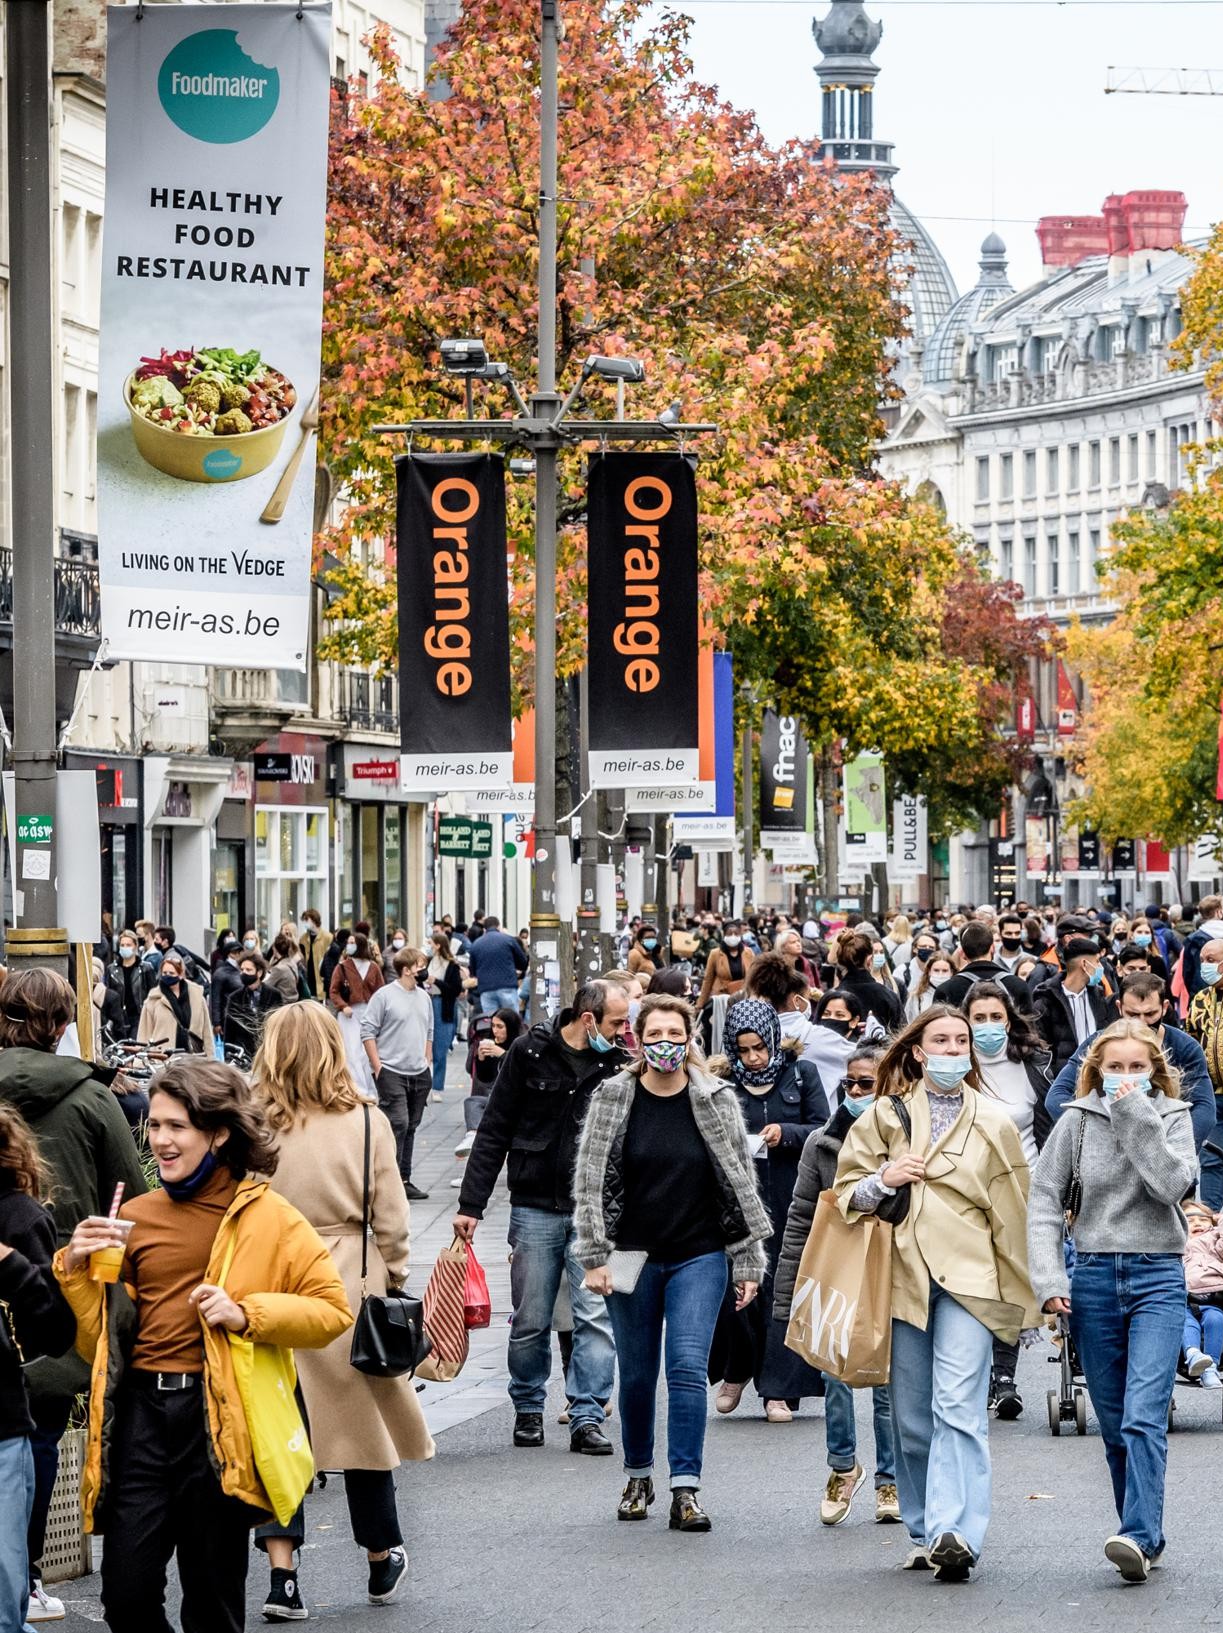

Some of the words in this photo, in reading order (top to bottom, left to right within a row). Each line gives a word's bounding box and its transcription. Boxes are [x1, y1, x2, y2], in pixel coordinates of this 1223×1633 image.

[172, 71, 268, 98] Foodmaker
[150, 187, 283, 216] HEALTHY
[175, 223, 256, 248] FOOD
[117, 255, 310, 288] RESTAURANT
[122, 552, 169, 571] LIVING
[173, 555, 194, 573] ON
[198, 556, 227, 575] THE
[424, 477, 480, 697] Orange
[613, 475, 673, 693] Orange
[127, 605, 280, 637] meir-as.be
[772, 715, 796, 783] fnac
[356, 766, 387, 776] Triumph
[415, 760, 499, 776] meir-as.be
[603, 757, 685, 773] meir-as.be
[476, 789, 535, 802] meir-as.b
[637, 787, 704, 800] meir-as.be
[682, 822, 728, 831] meir-as.be
[904, 799, 917, 860] PULL&BE
